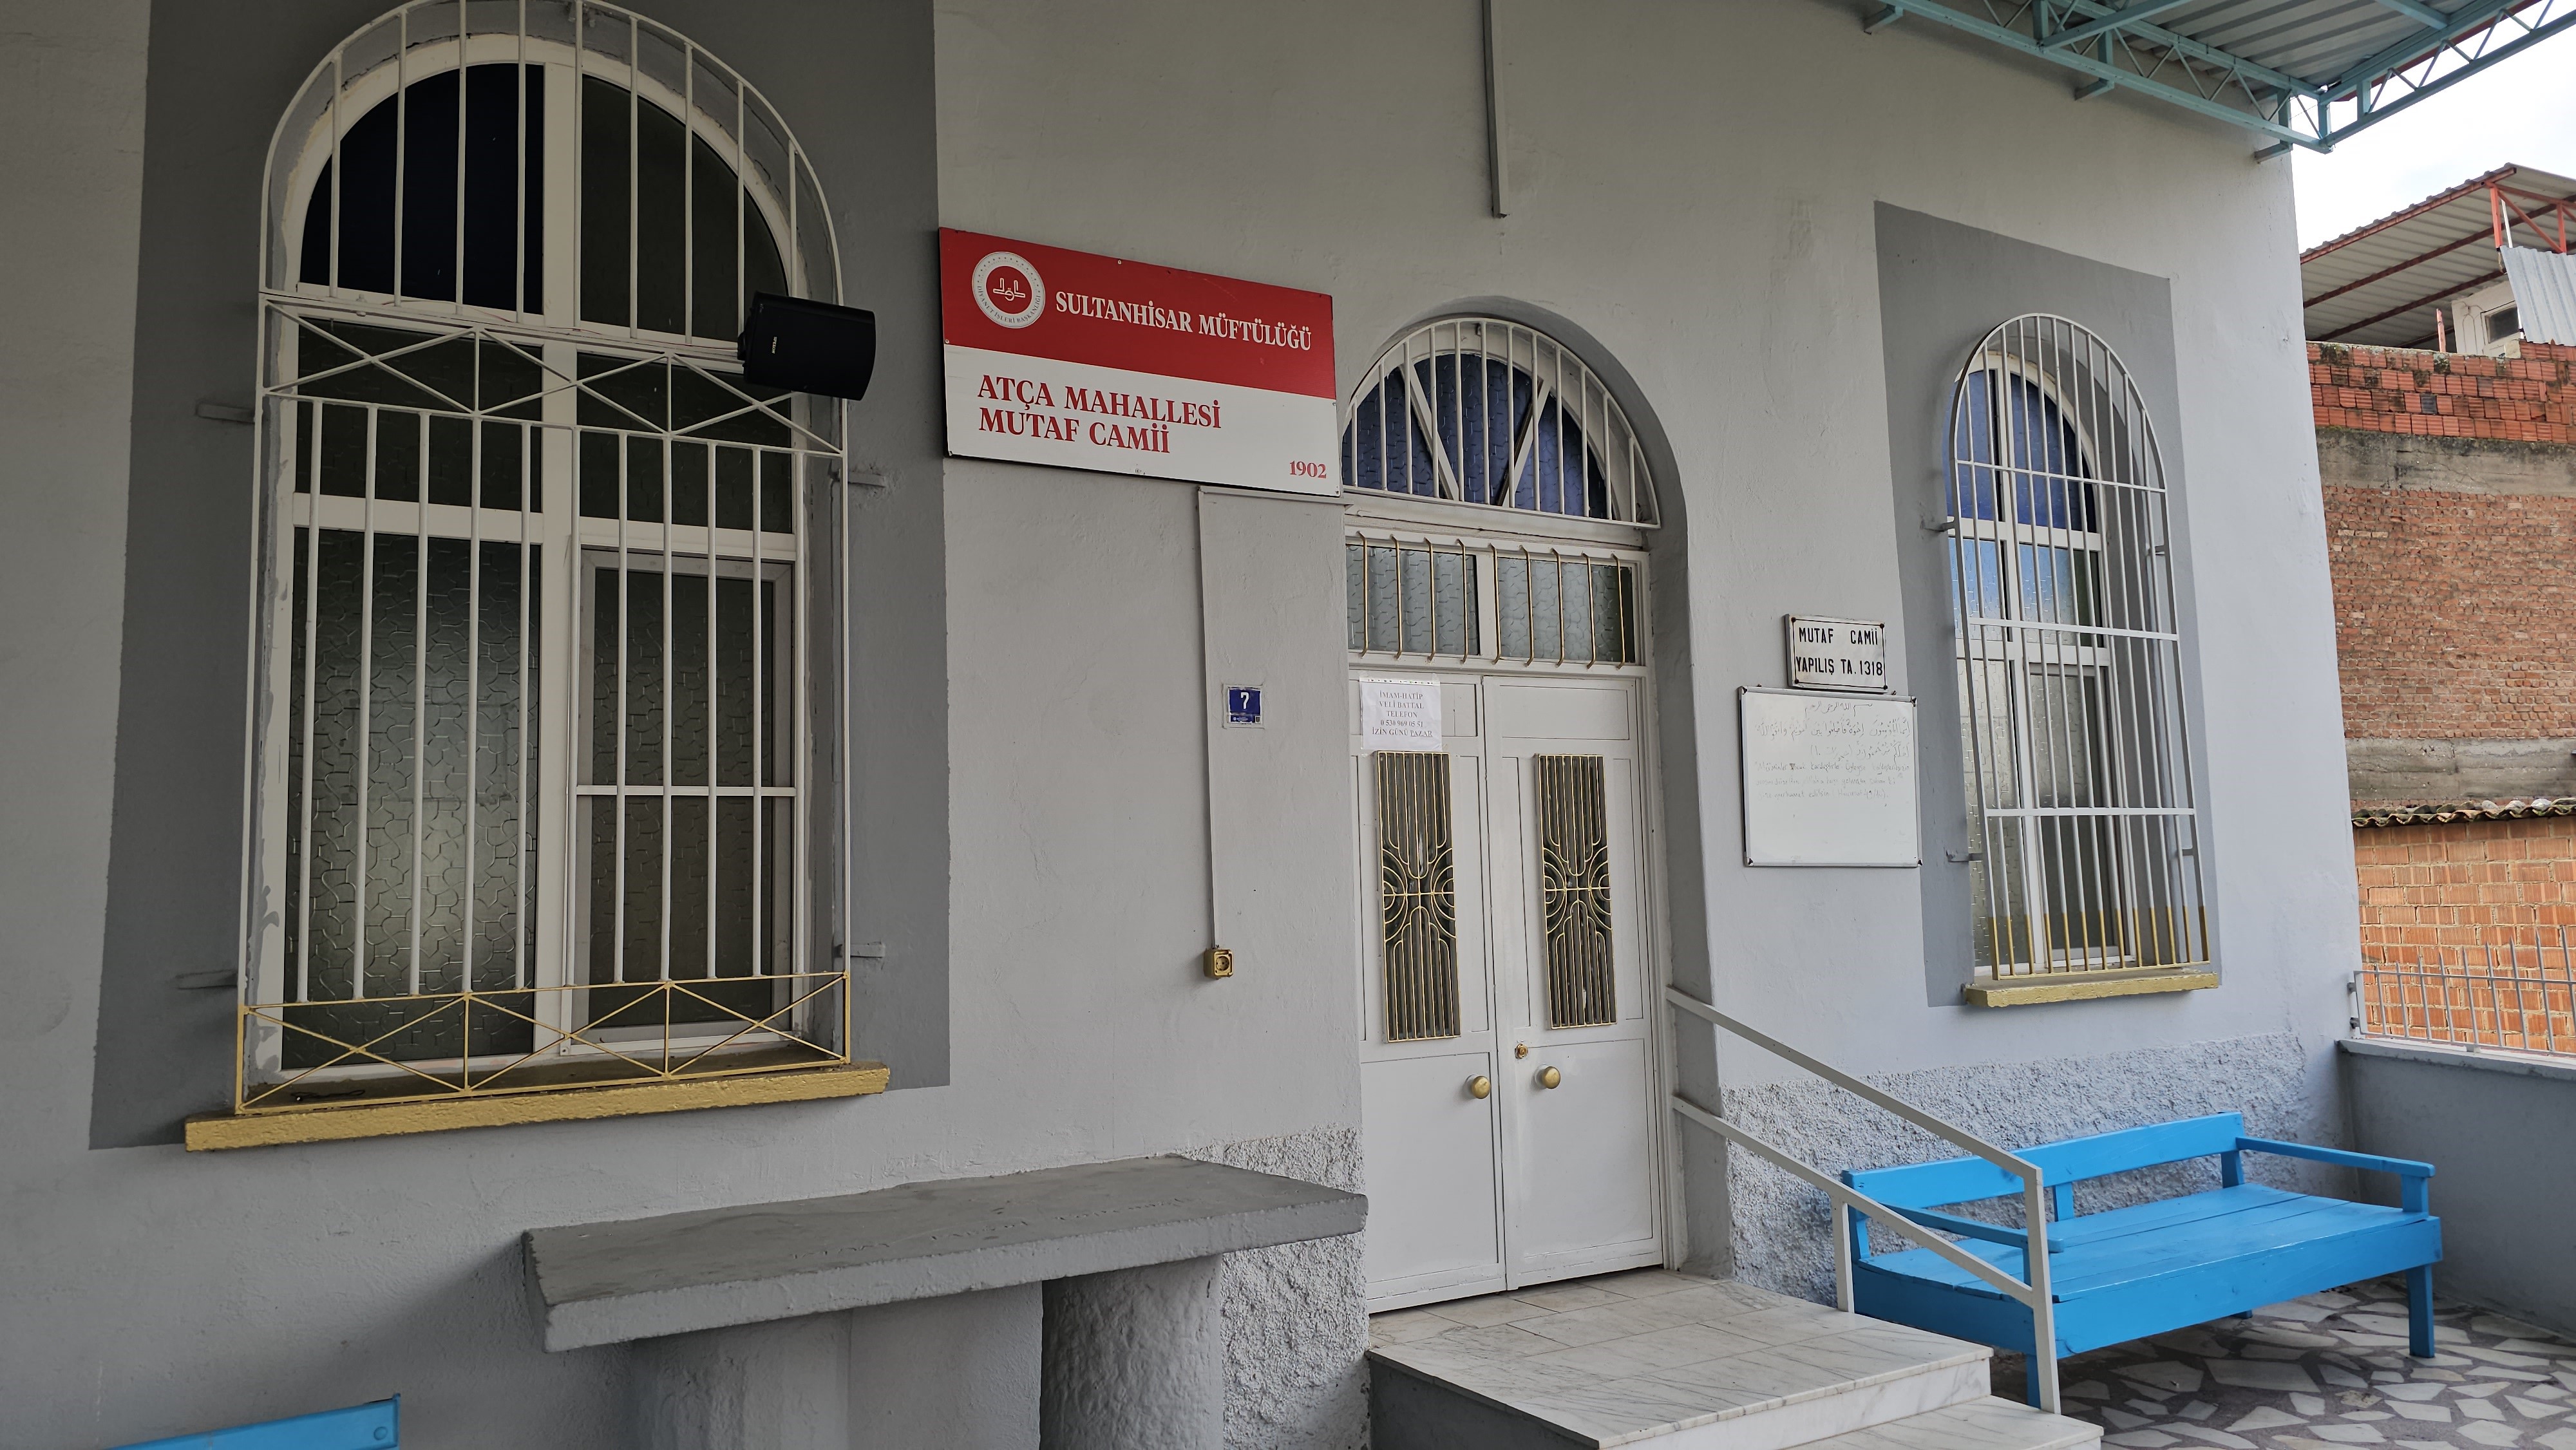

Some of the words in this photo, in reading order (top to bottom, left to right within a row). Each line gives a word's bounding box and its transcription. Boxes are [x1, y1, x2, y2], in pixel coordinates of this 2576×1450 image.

[1056, 291, 1193, 332] SULTANHİSAR
[1198, 312, 1312, 351] MÜFTÜLÜĞÜ
[978, 374, 1055, 410] ATÇA
[1064, 386, 1222, 429] MAHALLESİ
[978, 407, 1080, 442] MUTAF
[1089, 422, 1171, 454] CAMİİ
[1289, 460, 1327, 478] 1902
[1799, 626, 1834, 644] MUTAF
[1850, 628, 1879, 646] CAMİİ
[1795, 656, 1835, 675] YAPILIŞ
[1240, 692, 1249, 710] 7
[1379, 690, 1423, 700] İMAM-HATİP
